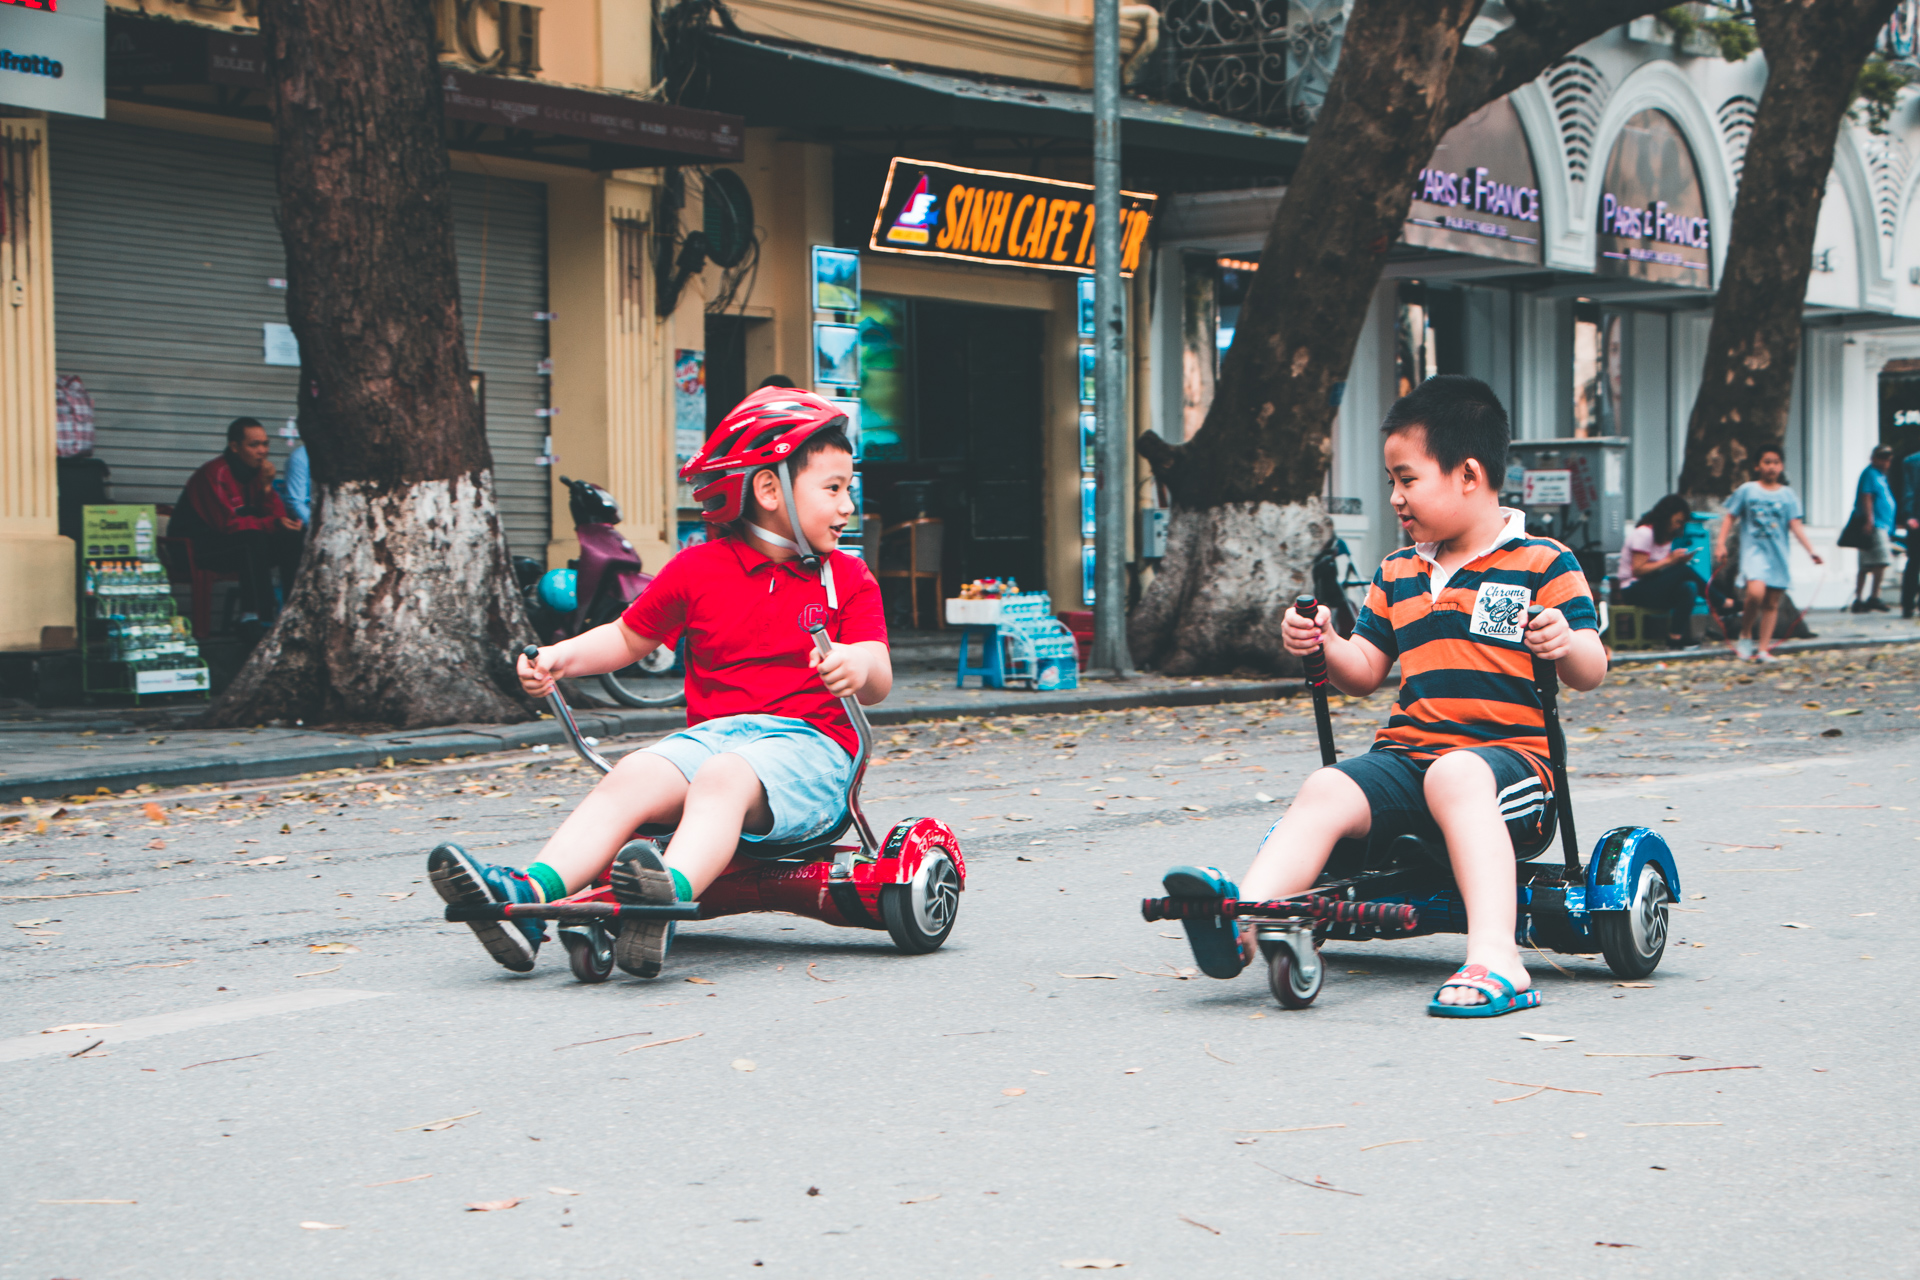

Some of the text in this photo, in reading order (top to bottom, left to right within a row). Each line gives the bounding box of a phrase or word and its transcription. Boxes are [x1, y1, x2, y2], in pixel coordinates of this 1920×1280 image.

[0, 49, 64, 79] frotto
[1475, 166, 1539, 222] FRANCE
[935, 184, 1014, 253] SINH
[1007, 193, 1082, 262] CAFE
[1603, 193, 1642, 239] PARIS
[1656, 201, 1709, 249] FRANCE
[1485, 585, 1525, 597] Chrome
[804, 603, 823, 628] C
[1479, 620, 1518, 635] Rollers
